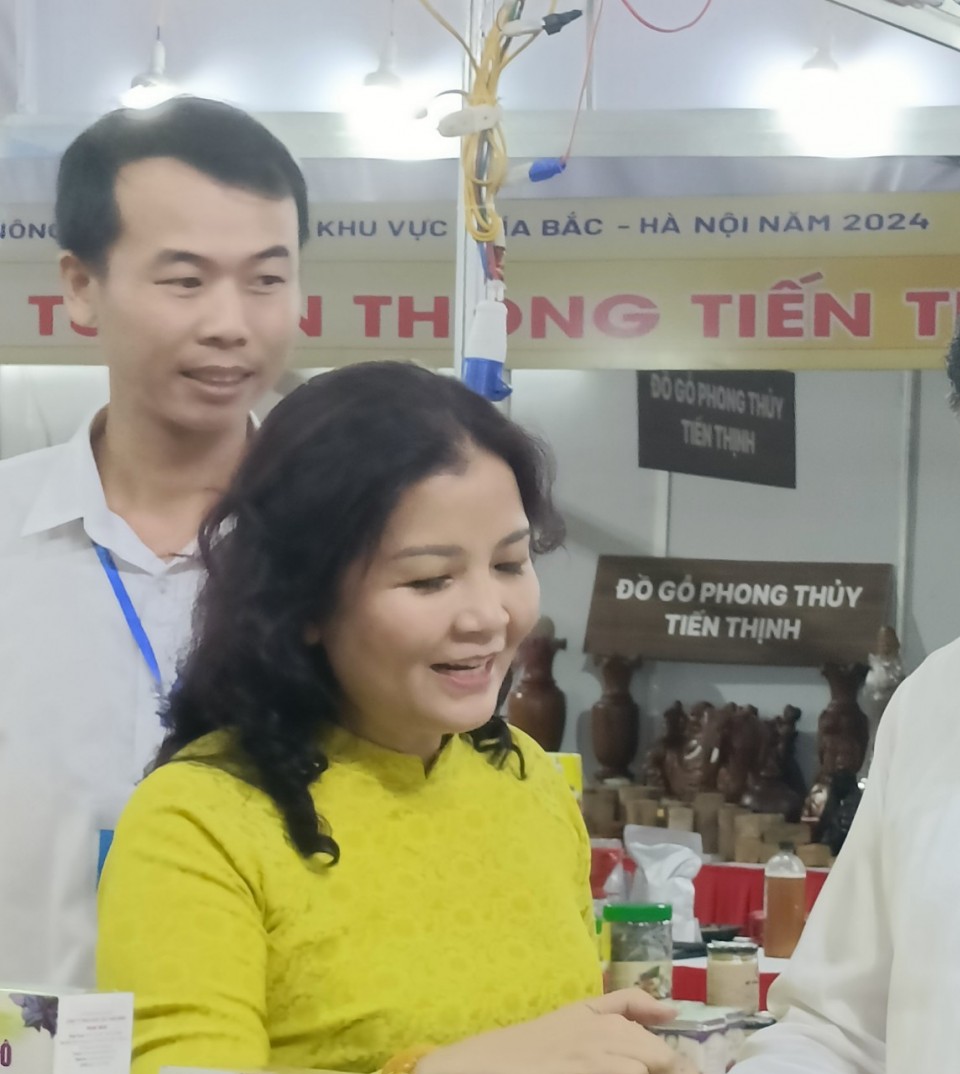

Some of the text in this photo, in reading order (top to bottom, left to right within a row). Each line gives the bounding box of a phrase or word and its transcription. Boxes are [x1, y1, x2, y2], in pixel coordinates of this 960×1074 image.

[316, 210, 931, 242] KHU VỰC BẮC HÀ NỘI NĂM 2024
[691, 270, 872, 339] TIẾN
[698, 382, 746, 415] PHONG
[616, 573, 654, 601] ĐỒ
[699, 581, 788, 607] PHONG
[793, 578, 864, 608] THỦY
[665, 607, 802, 645] TIẾN THỊNH
